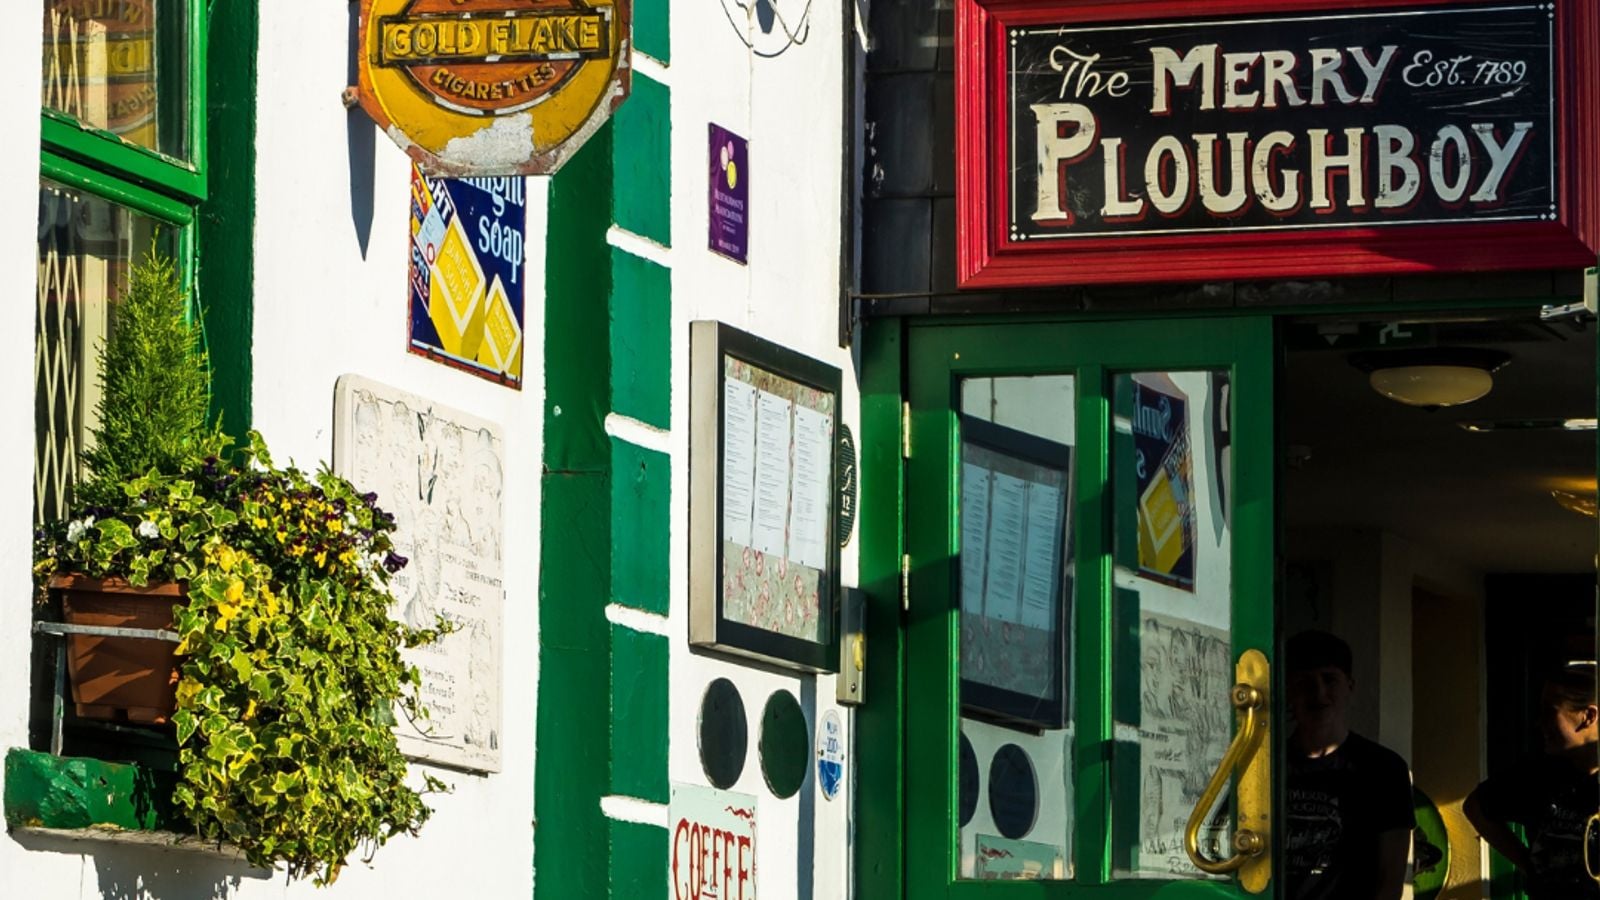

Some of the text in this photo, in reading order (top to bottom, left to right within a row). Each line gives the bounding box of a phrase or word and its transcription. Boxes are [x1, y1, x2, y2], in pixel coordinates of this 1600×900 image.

[392, 16, 600, 55] GOLD FLAKE
[433, 62, 556, 99] CIGARETTES
[1049, 44, 1527, 114] The MERRY Est. 1789
[1029, 103, 1535, 222] PLOUGHBOY
[478, 214, 523, 284] soap
